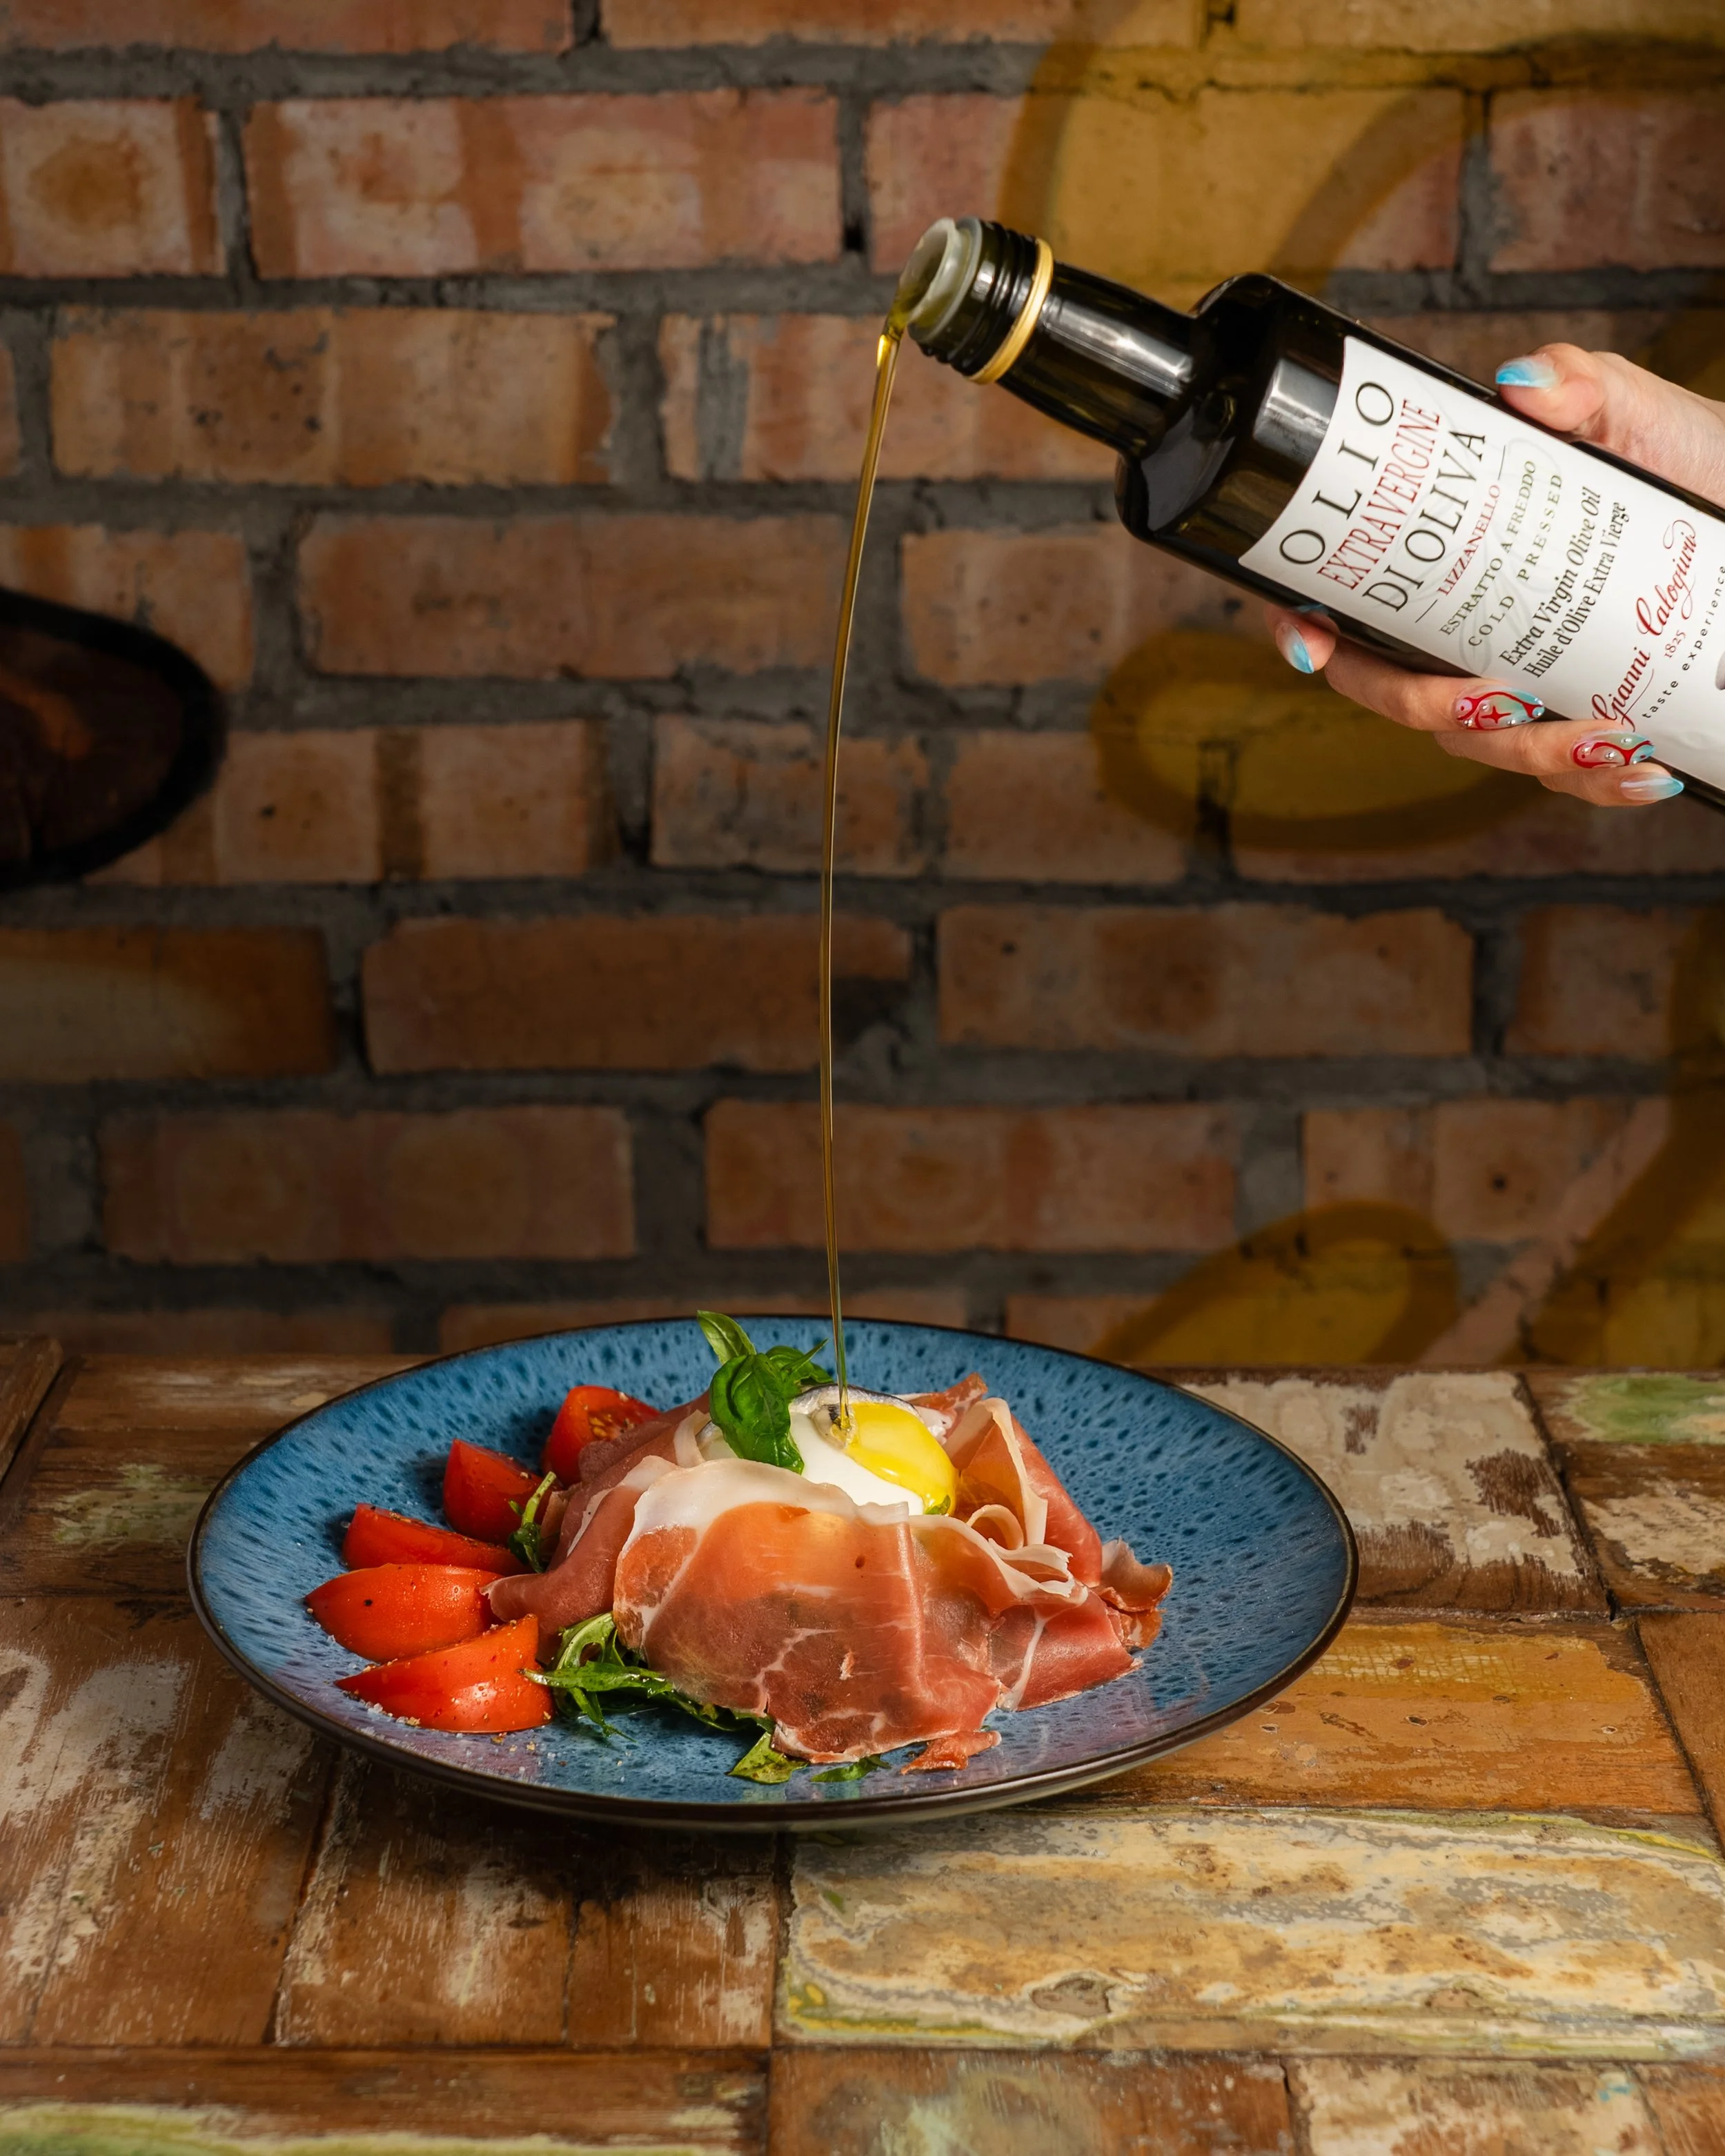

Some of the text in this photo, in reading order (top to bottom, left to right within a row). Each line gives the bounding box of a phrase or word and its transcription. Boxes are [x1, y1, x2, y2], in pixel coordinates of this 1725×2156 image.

[1279, 381, 1394, 564] OLIO
[1362, 430, 1486, 612] DI OLIVA
[1437, 484, 1500, 595] LIZZANELLO
[1439, 460, 1536, 635] ESTRATTO A FREDDO
[1468, 475, 1561, 646] COLD PRESSED
[1499, 486, 1601, 666] Extra Virgin Olive Oil
[1522, 644, 1564, 678] Huile
[1583, 551, 1615, 595] Extra
[1600, 502, 1630, 548] Vierge
[1591, 520, 1696, 732] Gianni Calogiuri
[1642, 566, 1725, 719] taste experience
[1664, 629, 1686, 659] 1825
